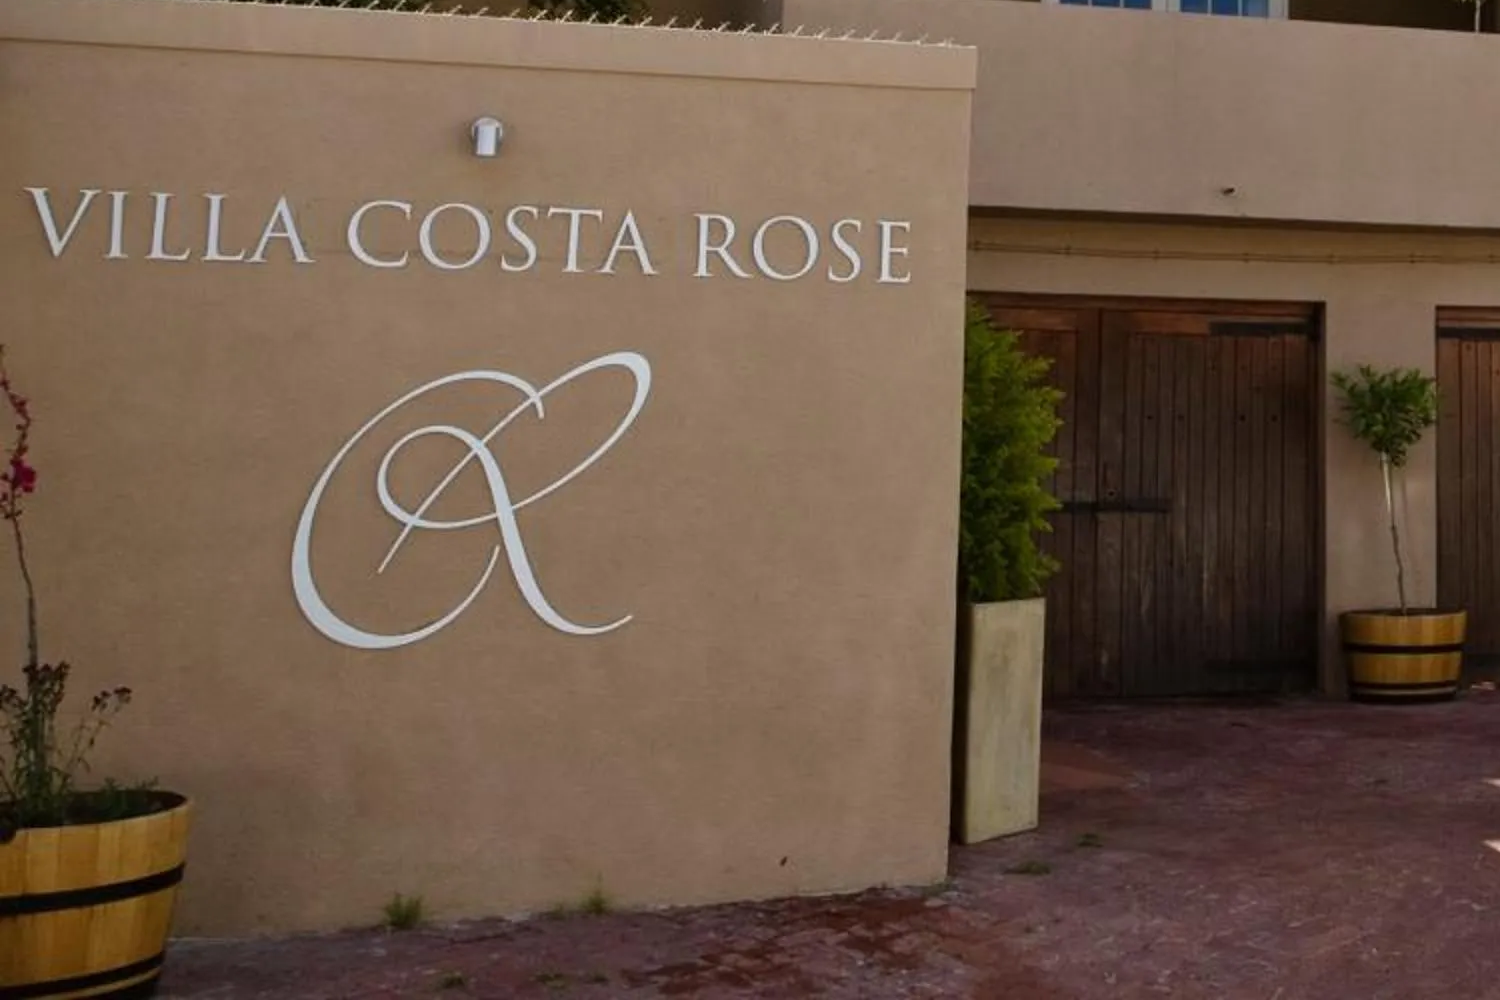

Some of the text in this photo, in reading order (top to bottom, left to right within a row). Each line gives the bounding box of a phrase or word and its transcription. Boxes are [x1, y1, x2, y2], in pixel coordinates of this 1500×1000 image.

[24, 186, 913, 285] VILLA COSTA ROSE
